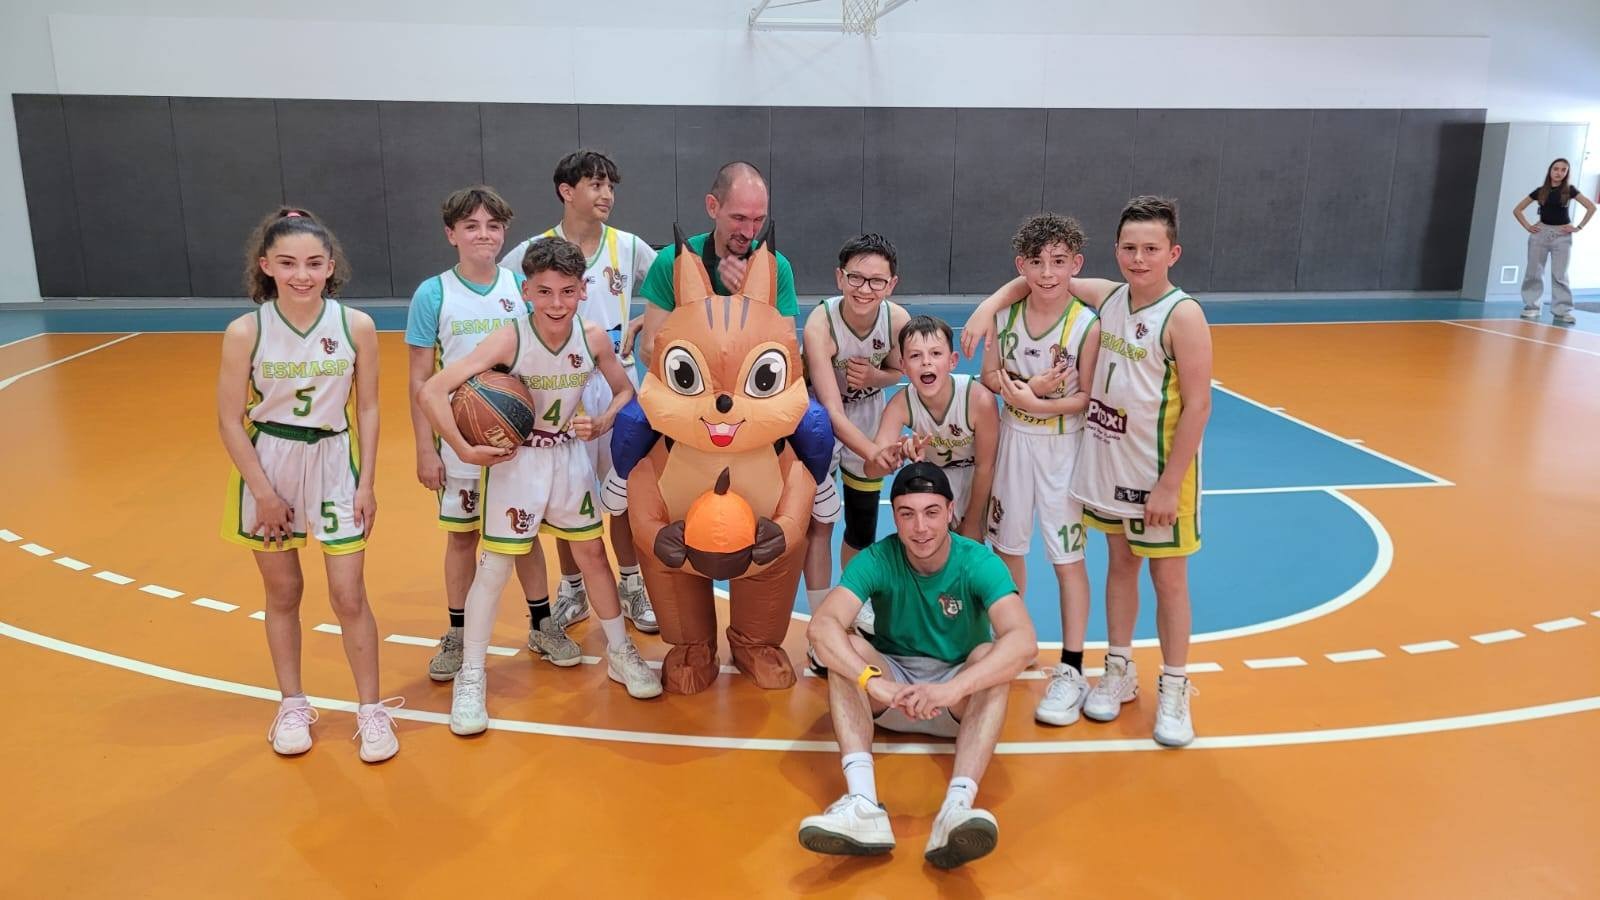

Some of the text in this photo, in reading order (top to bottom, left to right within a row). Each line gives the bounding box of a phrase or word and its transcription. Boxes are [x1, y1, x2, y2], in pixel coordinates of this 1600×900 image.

[262, 359, 350, 379] ESMASP
[293, 386, 316, 417] 5
[542, 398, 562, 426] 4
[320, 501, 339, 534] 5
[579, 490, 595, 519] 4
[1057, 523, 1082, 553] 12
